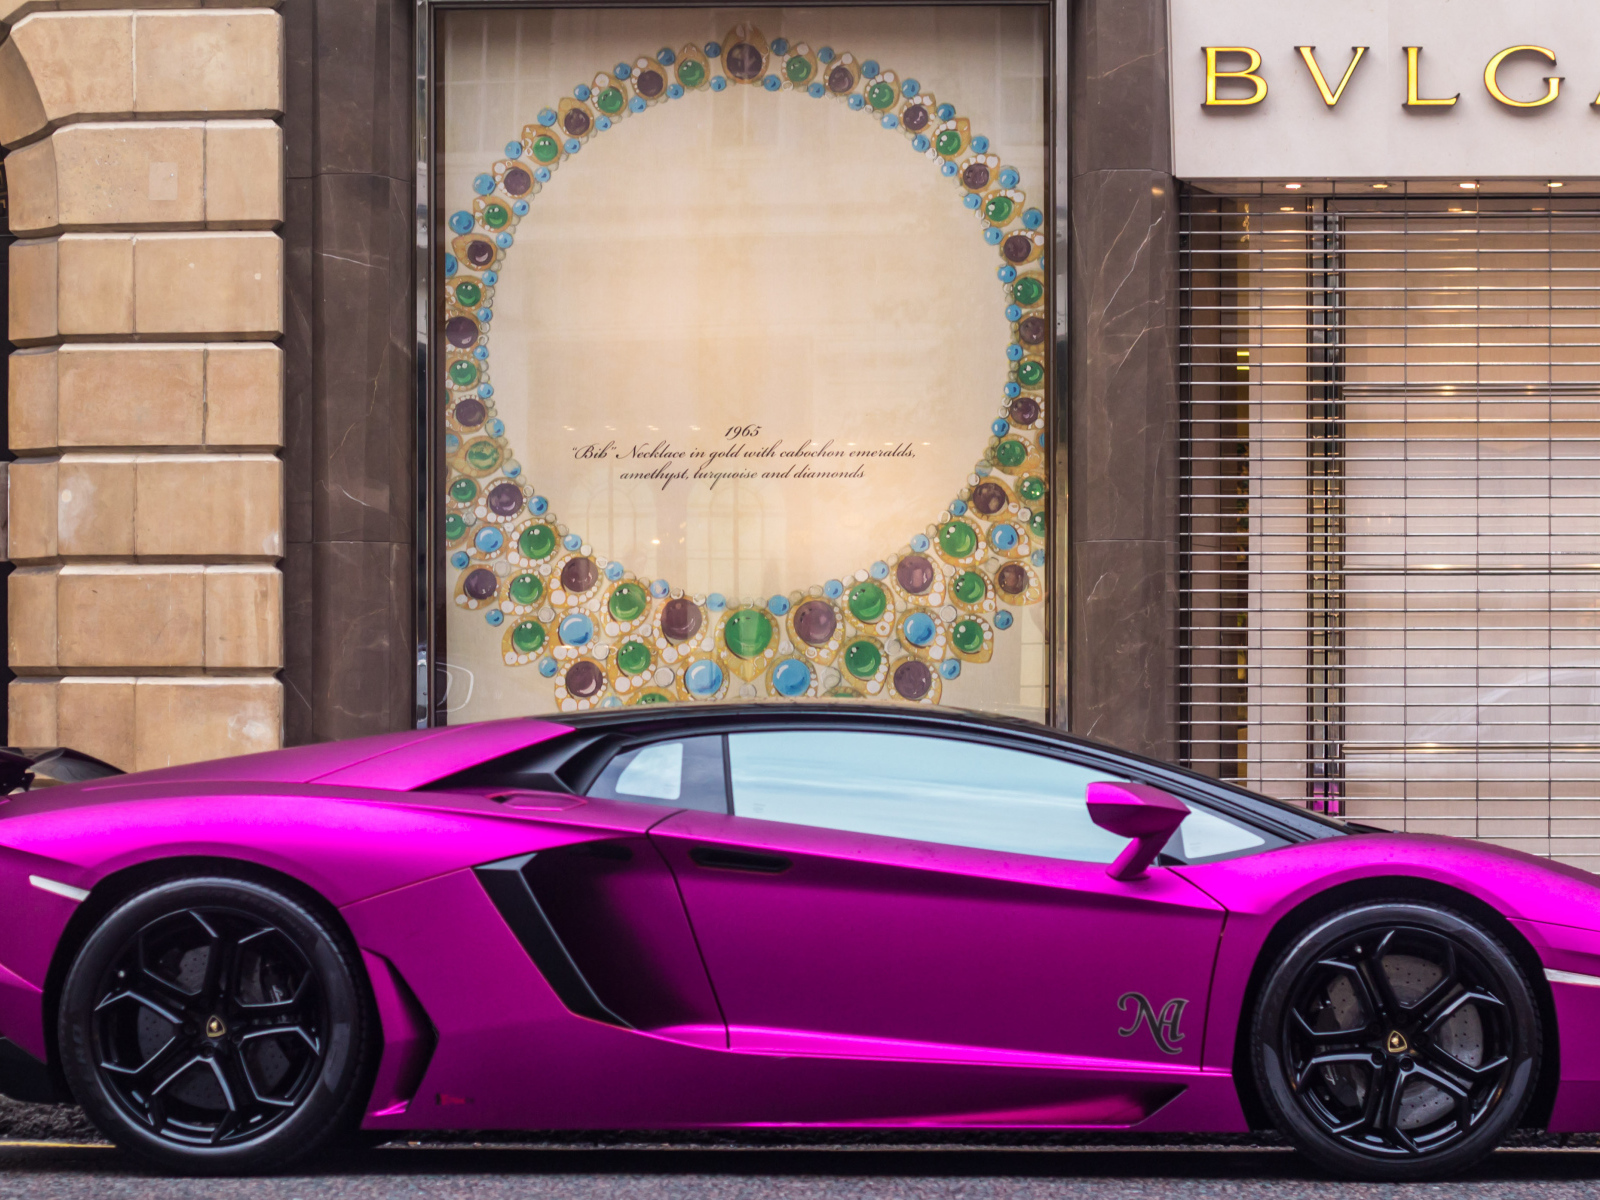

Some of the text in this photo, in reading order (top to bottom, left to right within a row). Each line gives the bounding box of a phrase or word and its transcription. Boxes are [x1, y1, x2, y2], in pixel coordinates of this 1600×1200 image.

[1201, 45, 1600, 108] BVLG
[724, 424, 762, 441] 1965
[616, 440, 686, 459] Necklace
[689, 447, 705, 459] in
[701, 443, 746, 468] gold
[743, 439, 783, 459] with
[779, 439, 846, 459] cabochon
[849, 443, 916, 459] emeralds,
[619, 461, 865, 491] amethyst, turquoise and diamonds
